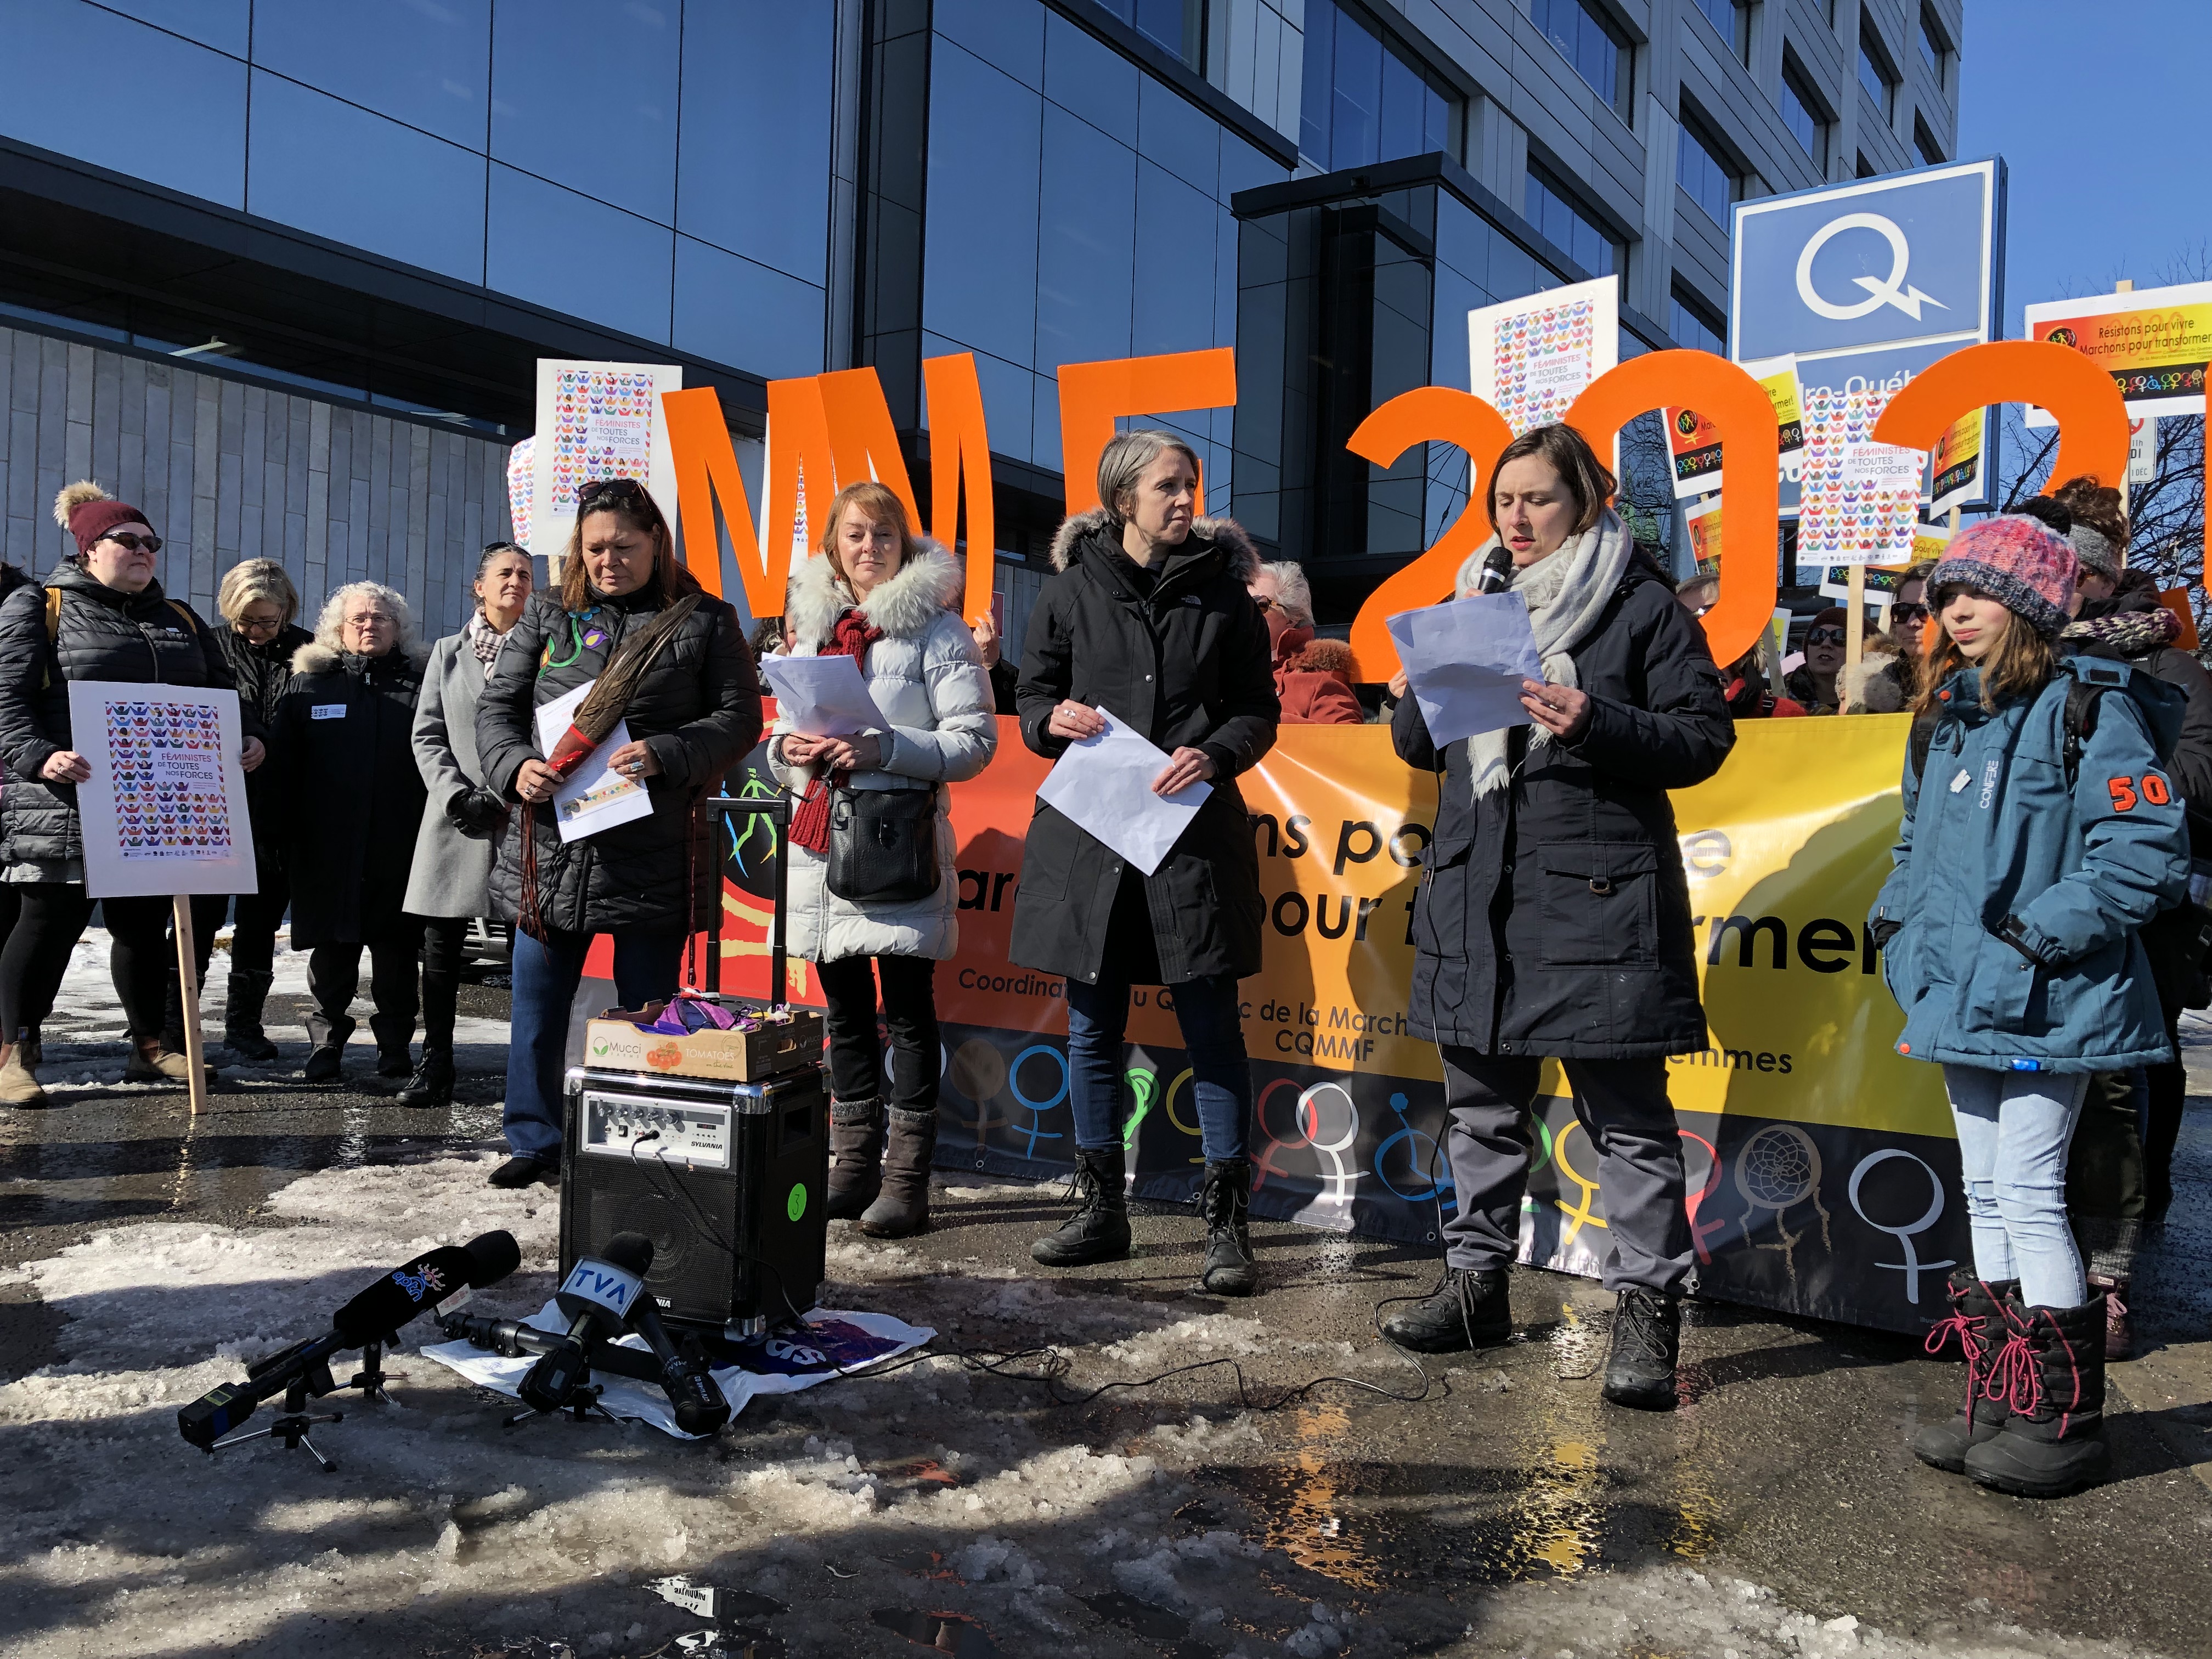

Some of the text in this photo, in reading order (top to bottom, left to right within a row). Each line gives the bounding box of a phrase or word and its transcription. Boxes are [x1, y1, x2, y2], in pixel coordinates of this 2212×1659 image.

[2099, 318, 2194, 338] Résistons pour vivre
[2080, 342, 2125, 356] Marchons
[2129, 340, 2152, 354] pour
[1533, 354, 1581, 370] FÉMINISTES
[1538, 365, 1568, 377] TOUTES
[1548, 371, 1581, 384] FORCES
[595, 418, 641, 428] FÉMINISTES
[599, 428, 628, 436] TOUTES
[609, 436, 640, 445] FORCES
[1853, 447, 1910, 456] FÉMINISTES
[1858, 456, 1893, 466] TOUTES
[1870, 466, 1909, 475] FORCES
[161, 752, 212, 762] FÉMINISTES
[167, 762, 199, 770] TOUTES
[180, 771, 213, 779] FORCES
[2107, 774, 2171, 813] 50
[1259, 891, 1383, 941] our
[959, 968, 1068, 999] Coordina
[1260, 999, 1291, 1023] de
[1299, 1002, 1320, 1026] la
[1328, 1006, 1409, 1037] March
[609, 1042, 641, 1054] Mucci
[1276, 1029, 1374, 1062] CQMMF
[686, 1048, 735, 1062] TOMATOES
[1668, 1048, 1792, 1074] emmes
[691, 1141, 723, 1150] SYLVANIA
[392, 1271, 422, 1302] aptn
[577, 1269, 626, 1305] TVA
